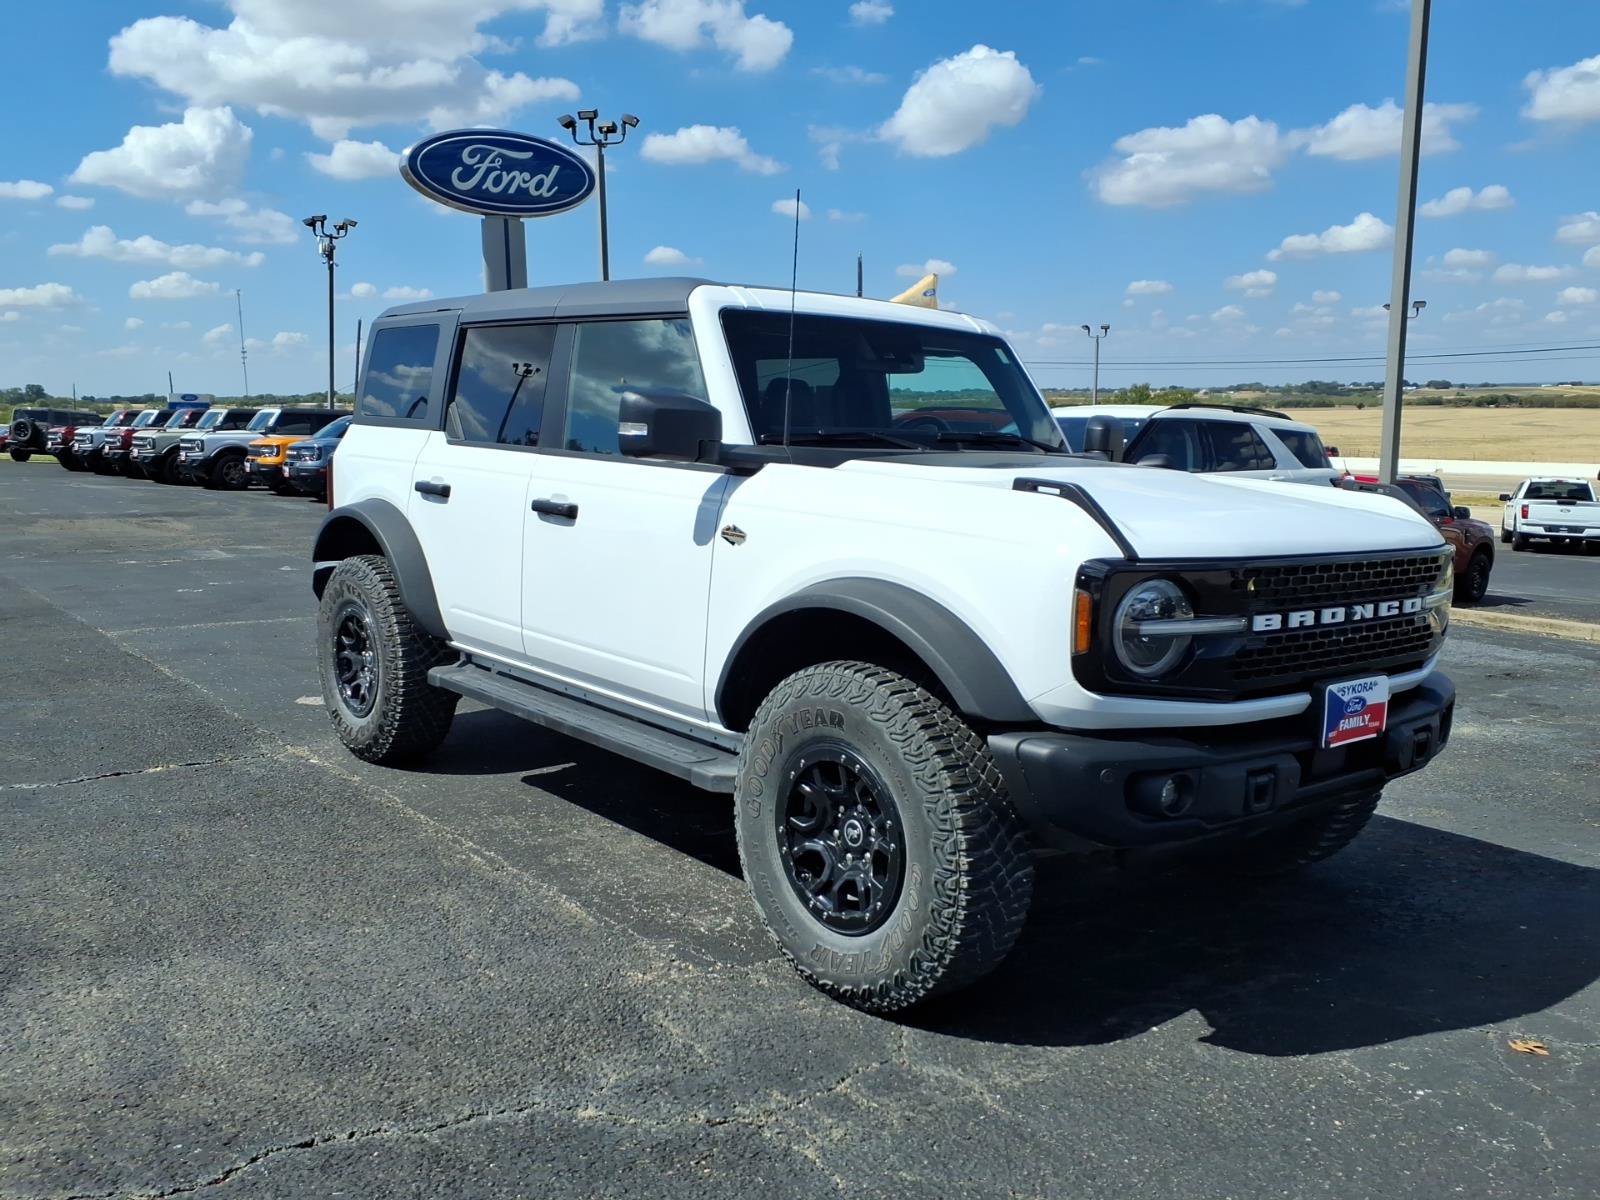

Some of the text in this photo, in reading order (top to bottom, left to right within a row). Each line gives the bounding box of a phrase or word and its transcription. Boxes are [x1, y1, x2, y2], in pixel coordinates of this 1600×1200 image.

[451, 144, 561, 198] Ford
[1252, 597, 1422, 632] BRONCO
[1340, 681, 1374, 697] SYKORA
[1339, 713, 1371, 732] FAMILY
